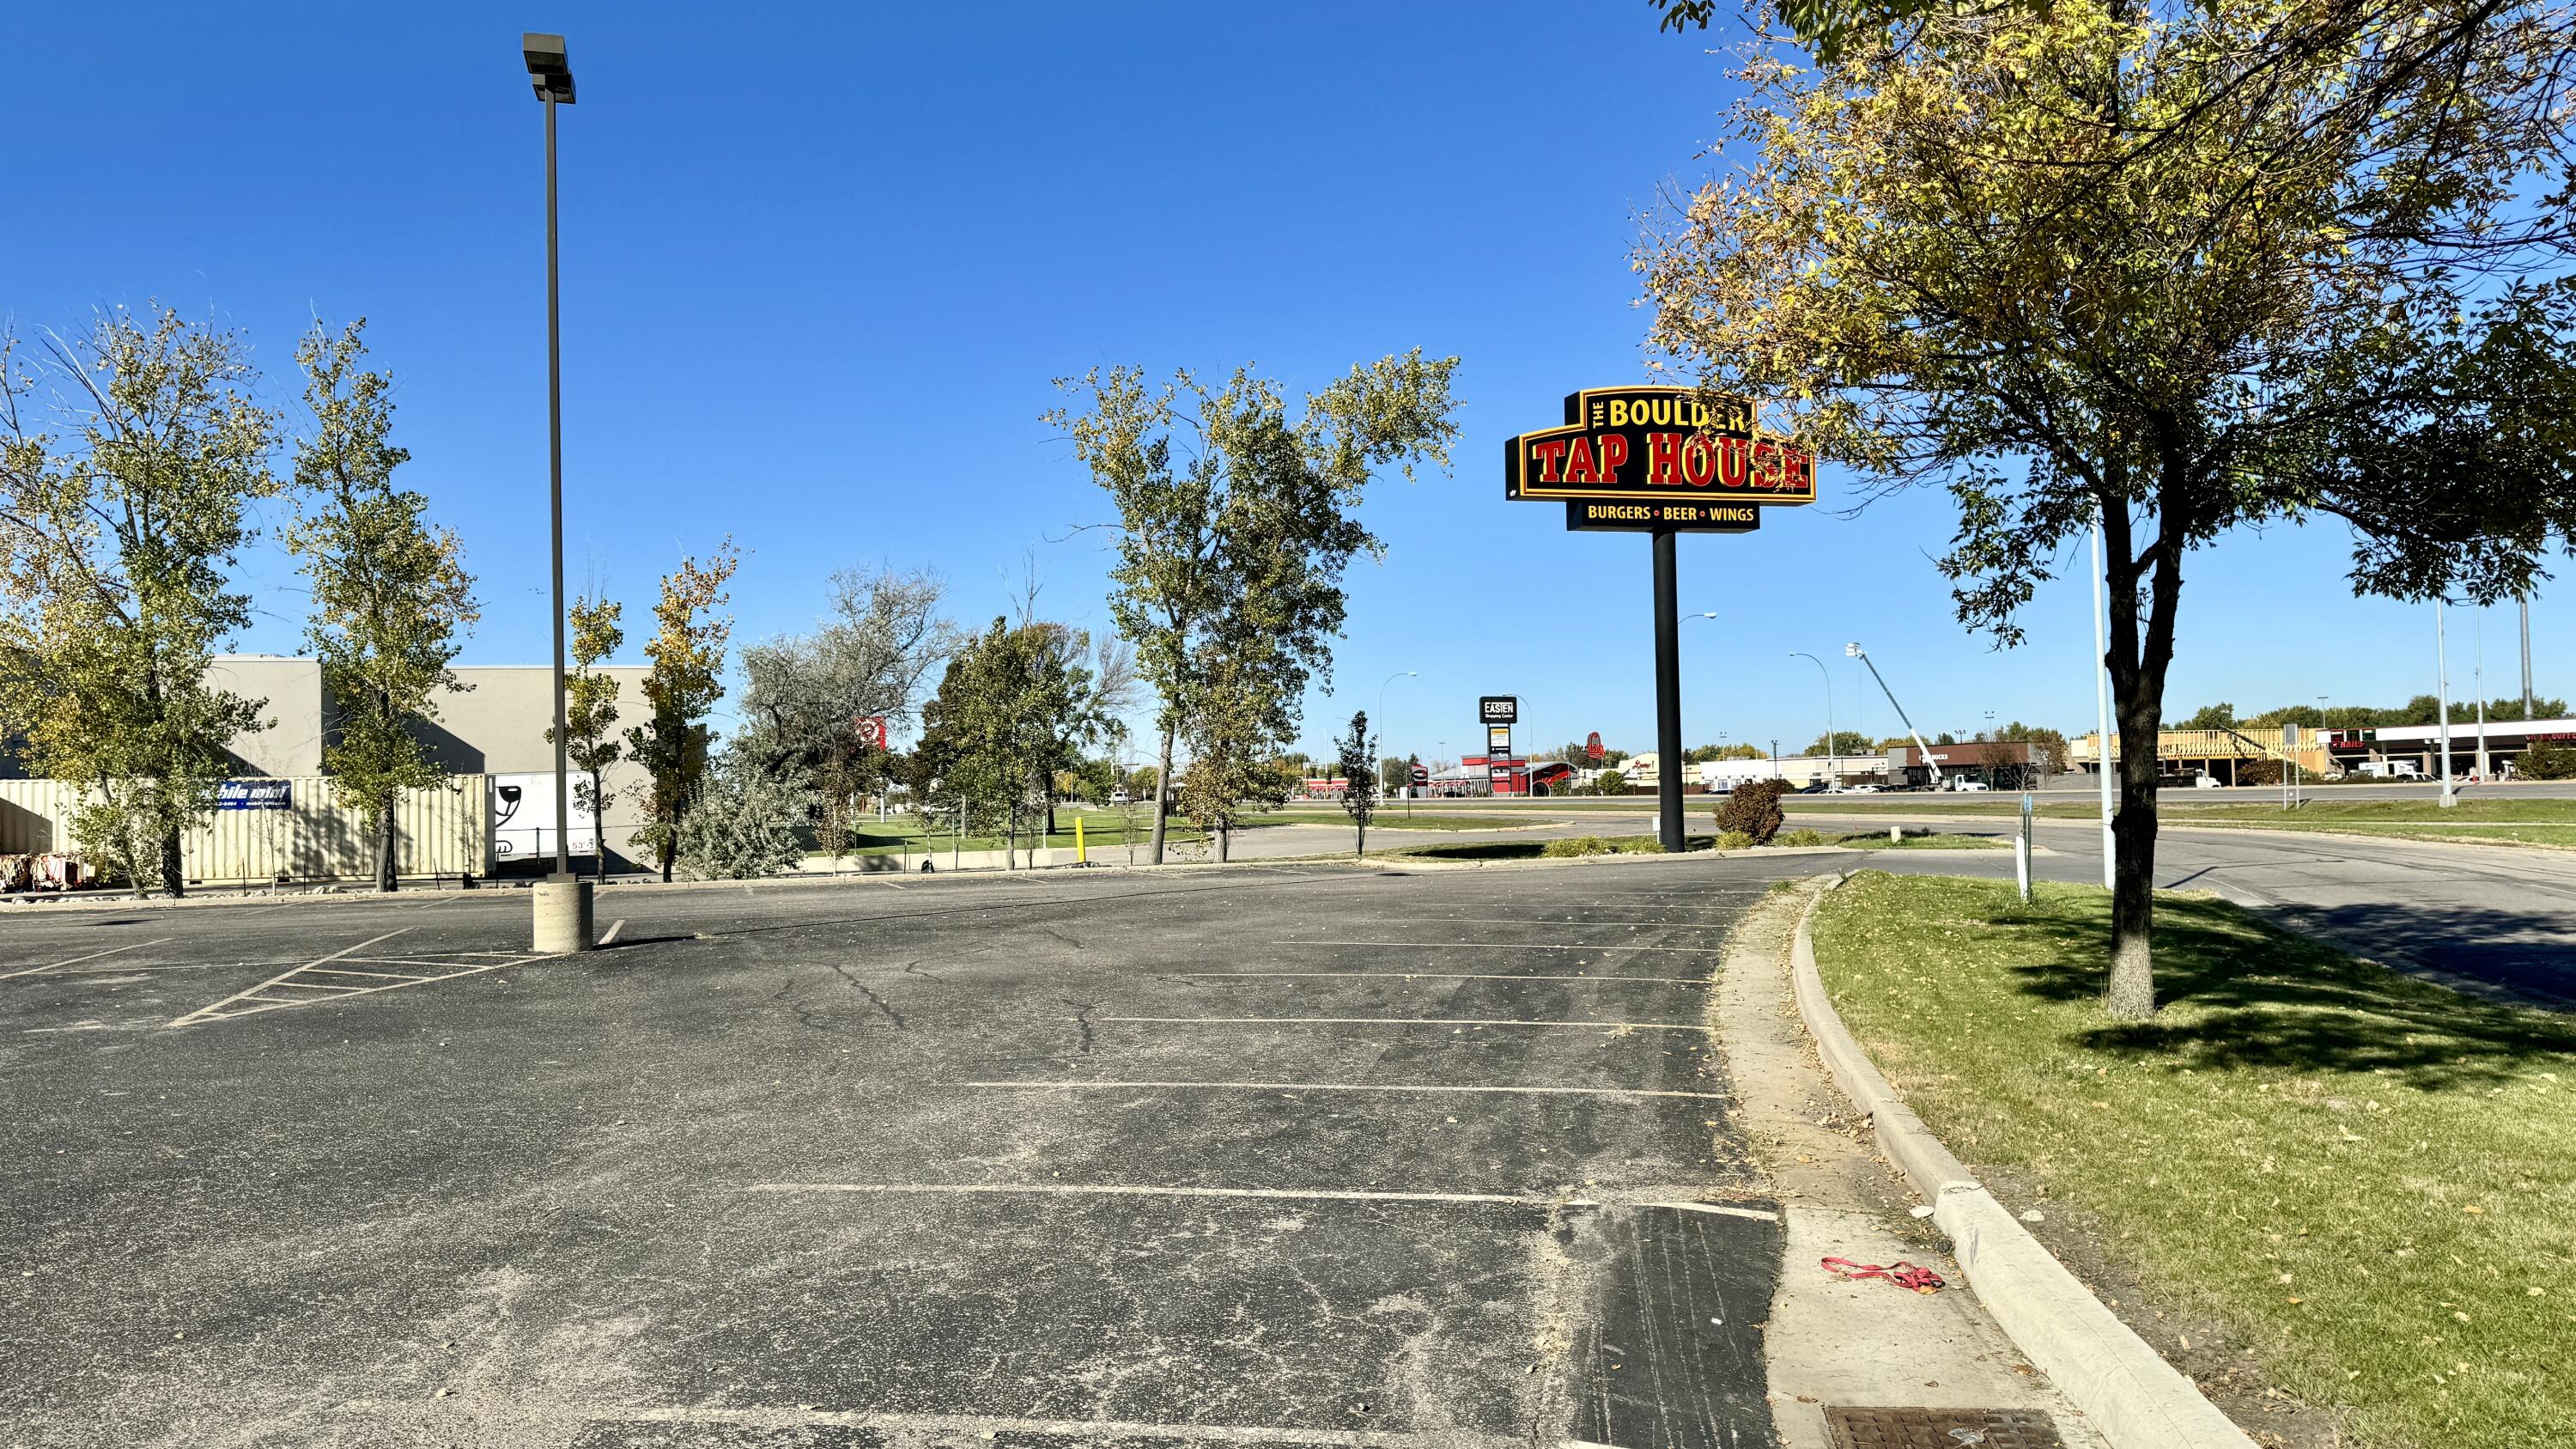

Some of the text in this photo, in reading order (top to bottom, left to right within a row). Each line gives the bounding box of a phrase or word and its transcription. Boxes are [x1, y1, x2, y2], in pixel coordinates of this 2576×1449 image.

[1593, 401, 1604, 429] THE
[1610, 399, 1745, 432] BOULDER
[1533, 433, 1808, 488] TAP HOUSE
[1589, 505, 1754, 521] BURGERS BEER WINGS
[1485, 702, 1513, 714] EASTEN
